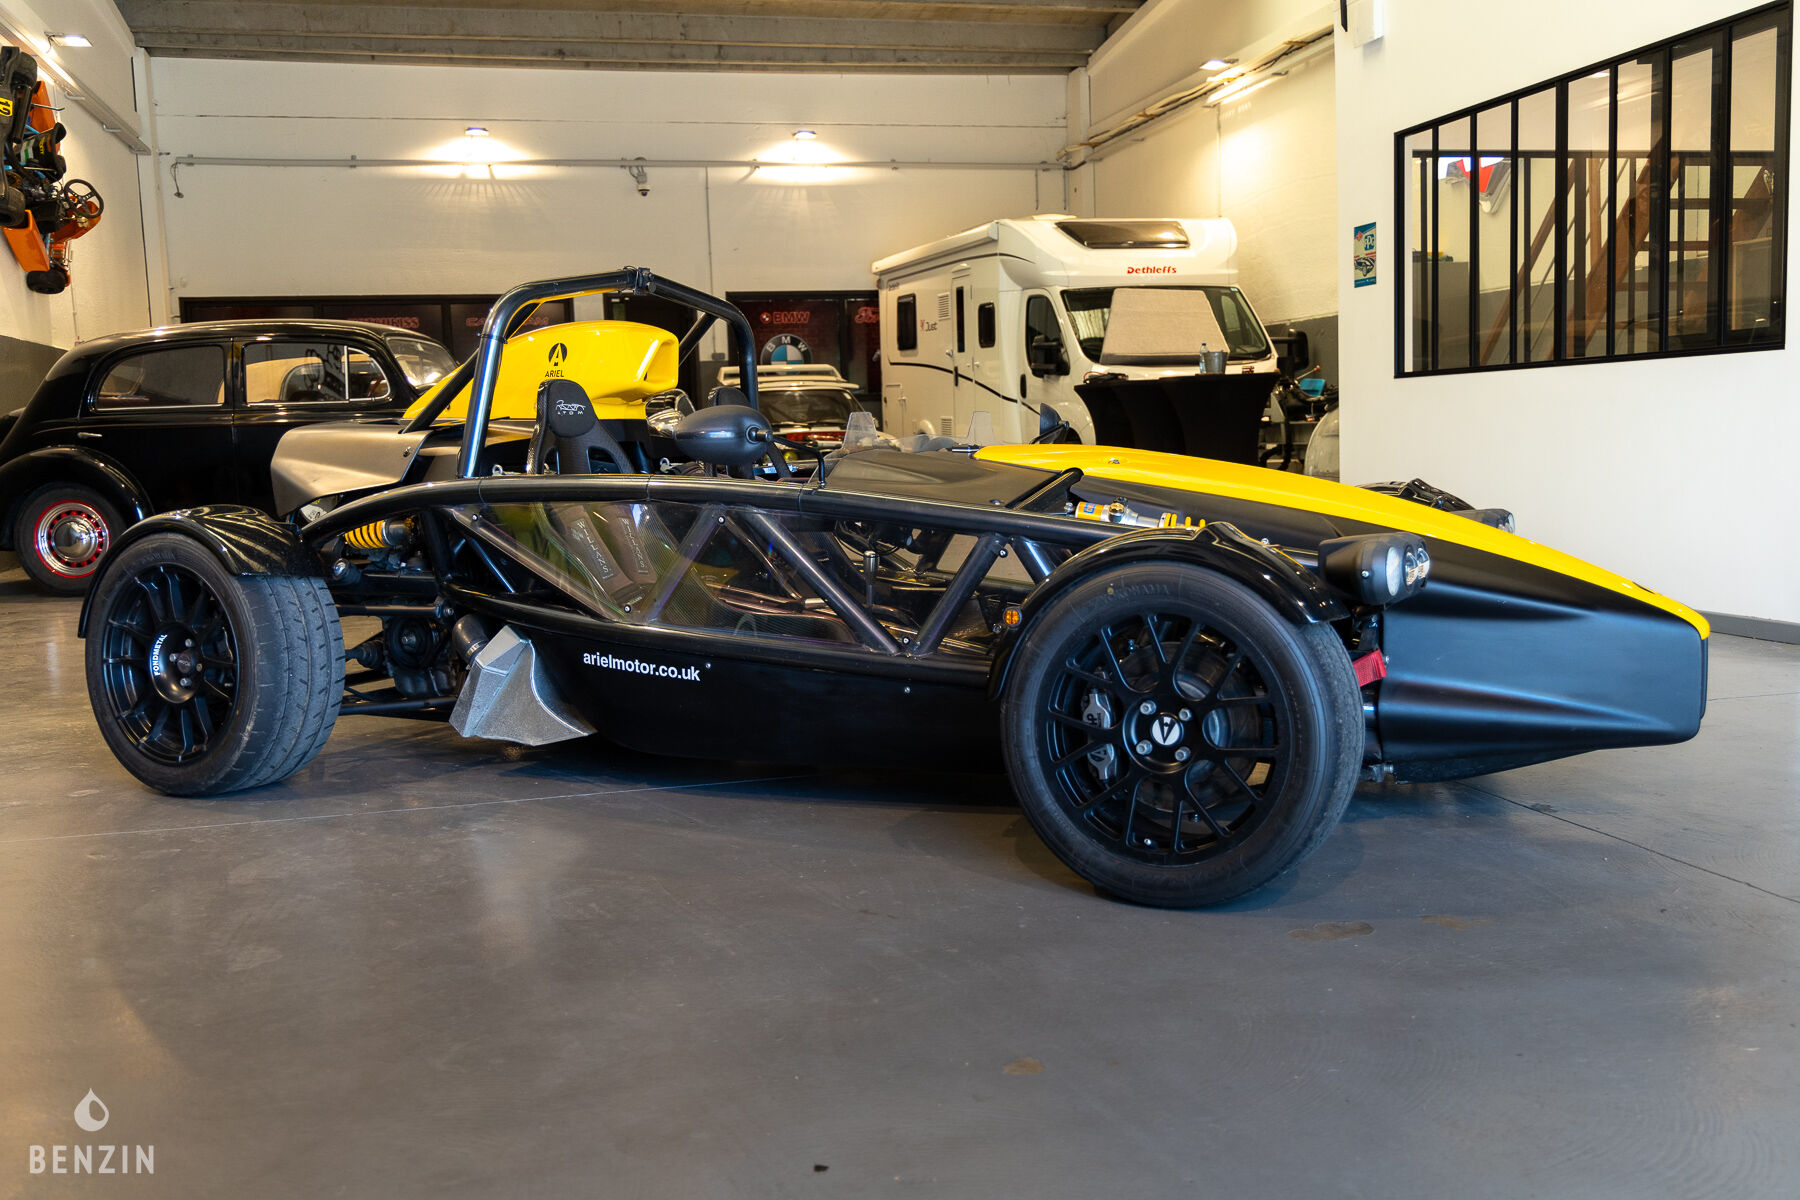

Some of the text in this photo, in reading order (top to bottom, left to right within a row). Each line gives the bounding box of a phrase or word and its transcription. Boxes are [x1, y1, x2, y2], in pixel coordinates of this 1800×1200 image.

[1127, 266, 1177, 274] Dethleffs
[773, 312, 810, 324] BMW
[766, 336, 808, 352] BMW
[152, 634, 168, 676] FONDMETAL
[583, 651, 701, 682] arielmotor.co.uk
